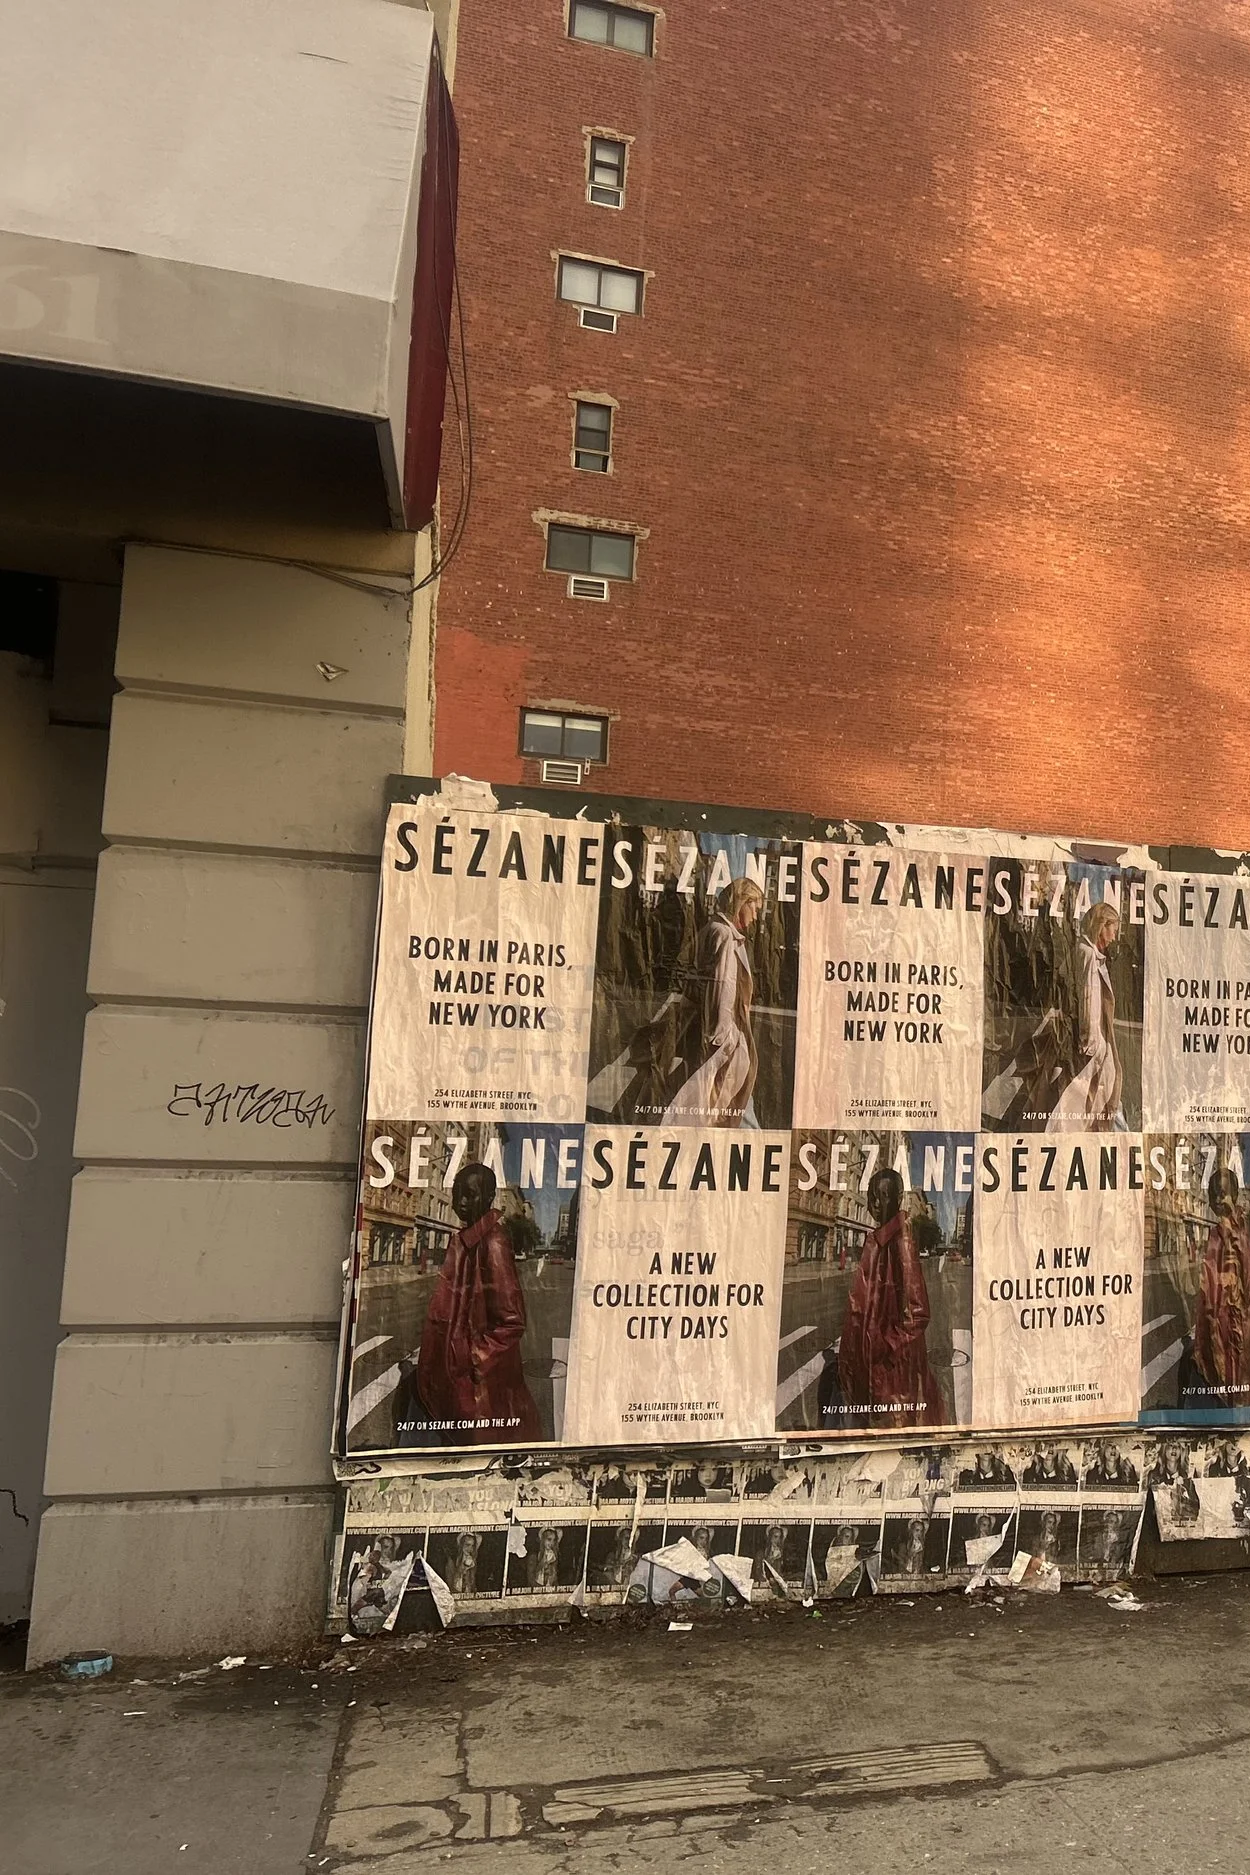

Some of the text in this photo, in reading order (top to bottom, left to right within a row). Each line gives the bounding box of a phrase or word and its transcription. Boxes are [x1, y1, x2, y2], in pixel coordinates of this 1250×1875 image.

[394, 816, 599, 887] SÉZANE
[610, 836, 798, 903] SÉZANE
[810, 851, 984, 913] SÉZANE
[993, 865, 1145, 925] SÉZANE
[408, 935, 573, 971] BORN IN PARIS,
[433, 969, 545, 998] MADE FOR
[825, 960, 964, 990] BORN IN PARIS,
[1166, 978, 1210, 999] BORN
[1216, 980, 1231, 1000] IN
[847, 991, 942, 1015] MADE FOR
[428, 1002, 480, 1026] NEW
[488, 1004, 547, 1030] YORK
[1184, 1006, 1230, 1026] MADE
[844, 1020, 944, 1044] NEW YORK
[1182, 1033, 1220, 1053] NEW
[427, 1100, 440, 1109] 155
[443, 1100, 468, 1109] WYTHE
[500, 1102, 537, 1111] BROOKLYN
[434, 1088, 449, 1097] 254
[450, 1089, 487, 1099] ELIZABETH
[518, 1091, 532, 1100] NYC
[592, 1131, 781, 1192] SÉZANE
[982, 1139, 1144, 1192] SÉZANE
[649, 1252, 717, 1275] A NEW
[1035, 1246, 1091, 1270] A NEW
[592, 1283, 764, 1308] COLLECTION FOR
[989, 1273, 1133, 1301] COLLECTION FOR
[626, 1315, 728, 1340] CITY DAYS
[1020, 1304, 1105, 1330] CITY DAYS
[621, 1414, 634, 1423] 155
[636, 1414, 660, 1422] WYTHE
[690, 1412, 724, 1421] BROOKLYN
[628, 1403, 642, 1411] 254
[644, 1402, 678, 1411] ELIZABETH
[707, 1401, 719, 1410] NYC
[822, 1402, 927, 1414] 24/7 ON SEZANE.COM AND THE APP
[397, 1417, 520, 1431] 24/7 ON SEZANE.COM AND THE APP
